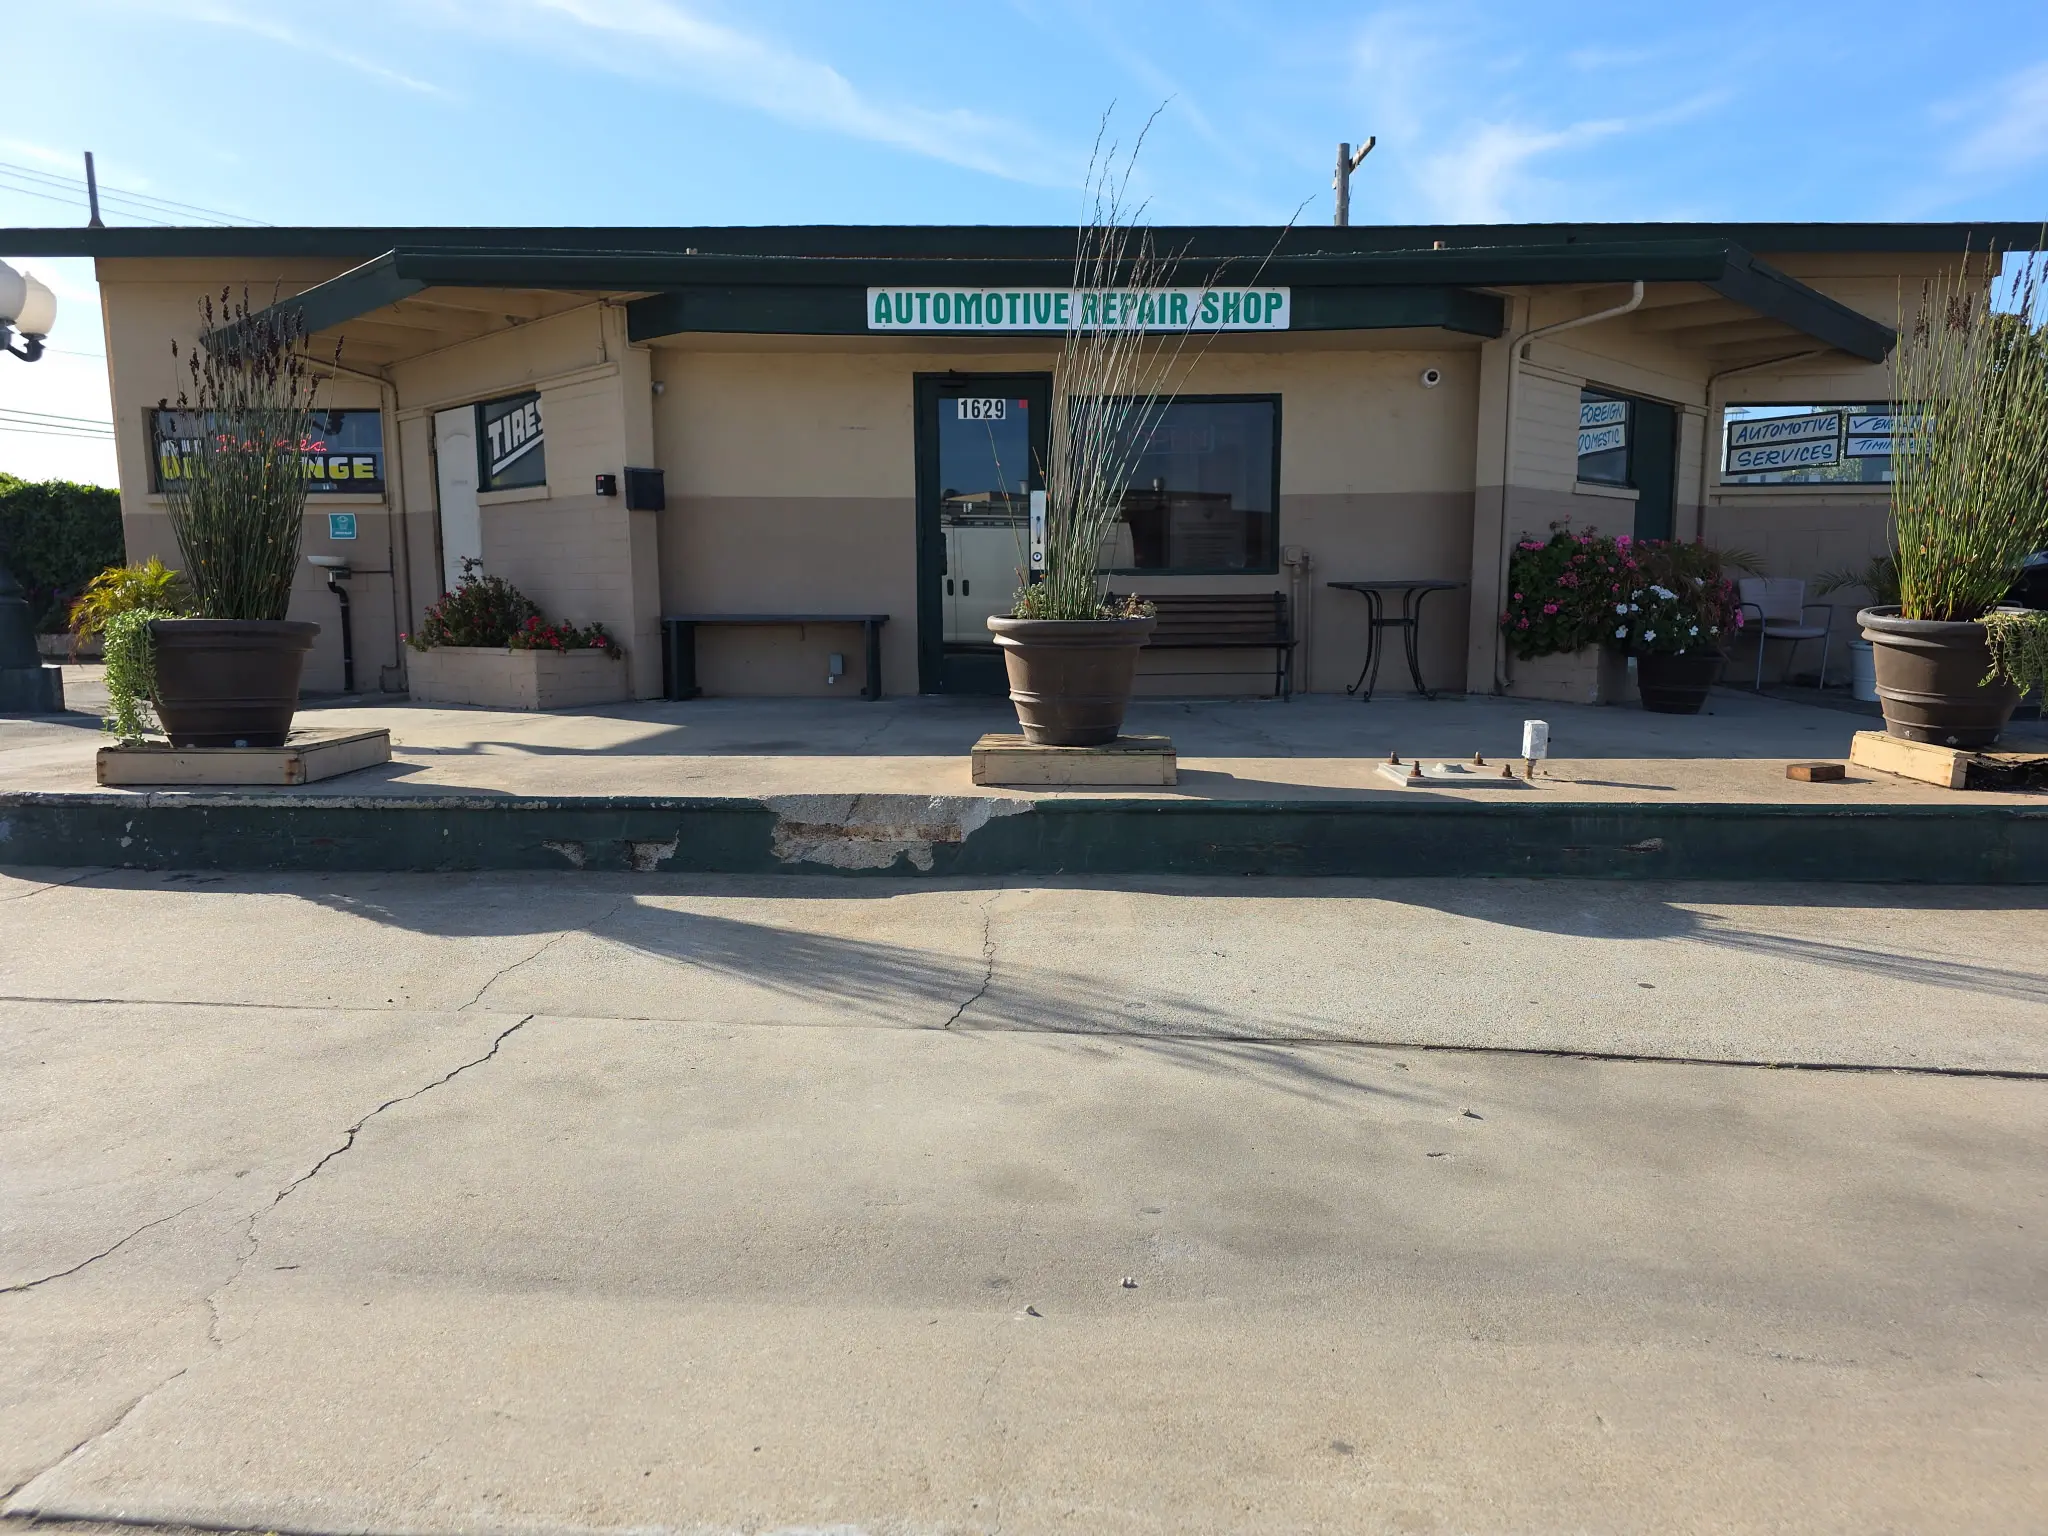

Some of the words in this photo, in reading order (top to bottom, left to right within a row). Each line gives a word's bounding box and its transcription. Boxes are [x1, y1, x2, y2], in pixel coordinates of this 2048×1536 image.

[874, 292, 1069, 324] AUTOMOTIVE
[1082, 292, 1188, 324] REPAIR
[1201, 291, 1282, 324] SHOP
[960, 399, 1004, 418] 1629
[1580, 403, 1624, 423] FOREIGN
[1578, 428, 1620, 452] DOMESTIC
[1735, 416, 1837, 443] AUTOMOTIVE
[1738, 443, 1832, 467] SERVICES
